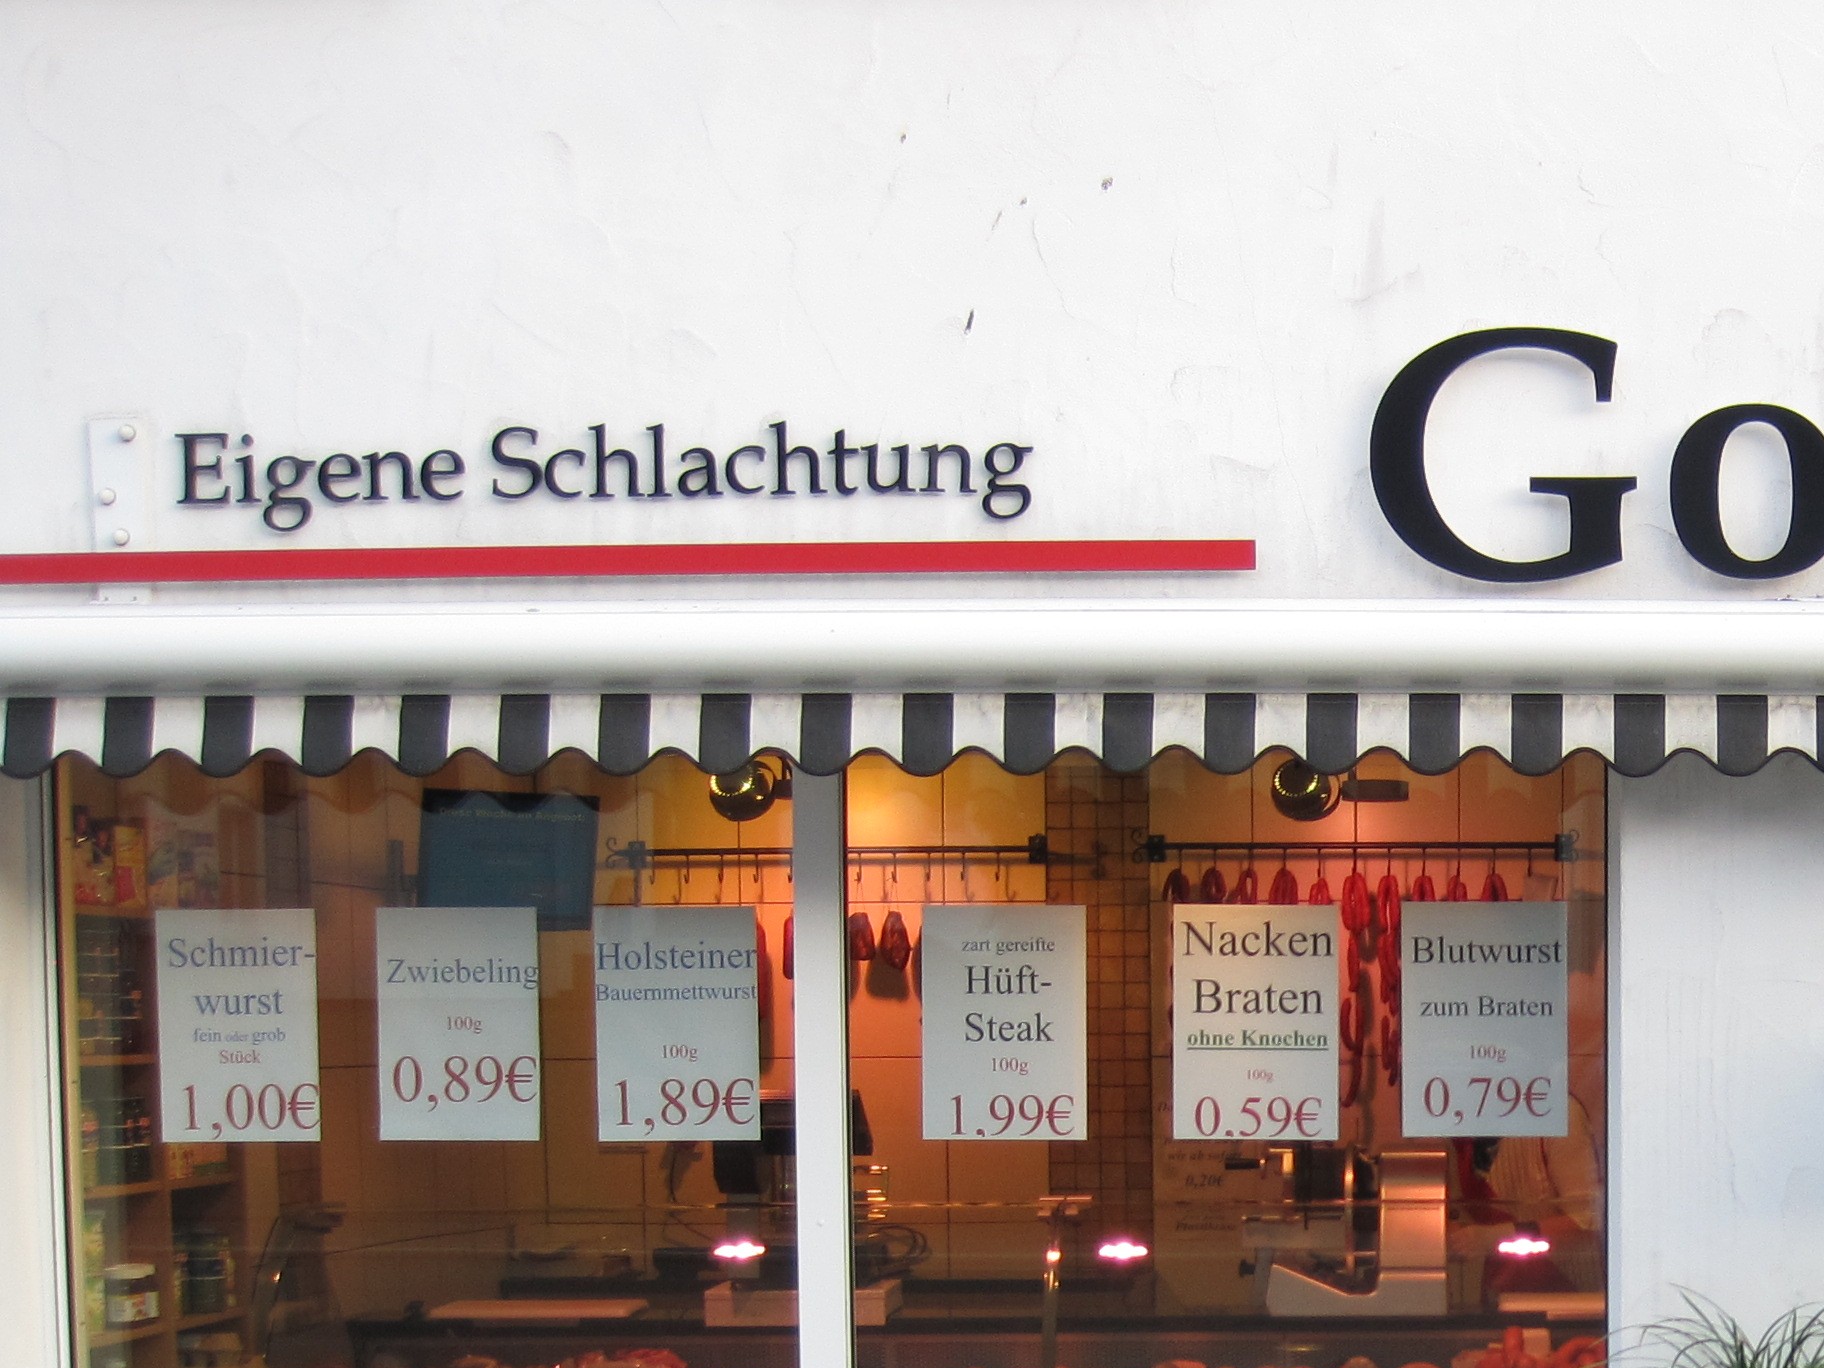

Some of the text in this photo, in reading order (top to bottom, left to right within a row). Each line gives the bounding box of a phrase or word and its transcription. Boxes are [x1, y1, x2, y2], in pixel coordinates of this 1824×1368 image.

[176, 421, 1033, 530] Eigene Schlachtung
[168, 937, 315, 968] Schmier-
[962, 937, 1056, 955] zart gereifte
[1181, 920, 1334, 957] Nacken
[1412, 936, 1562, 964] Blutwurst
[596, 941, 757, 970] Holsteiner
[387, 958, 539, 989] Zwiebeling
[964, 964, 1052, 995] Hüft-
[195, 989, 284, 1015] wurst
[596, 983, 757, 1002] Bauernmettwurst
[1193, 978, 1323, 1014] Braten
[1420, 996, 1553, 1016] zum Braten
[193, 1028, 222, 1043] fein
[252, 1028, 286, 1045] grob
[447, 1016, 482, 1034] 100g
[965, 1012, 1054, 1042] Steak
[1187, 1030, 1329, 1047] ohne Knochen
[219, 1050, 261, 1064] Stück
[661, 1044, 698, 1062] 100g
[991, 1057, 1029, 1075] 100g
[1470, 1045, 1506, 1062] 100g
[393, 1056, 537, 1112] 0,89€
[1246, 1069, 1274, 1083] 100g
[183, 1083, 320, 1139] 1,00€
[615, 1078, 755, 1136] 1,89€
[1424, 1076, 1552, 1125] 0,79€
